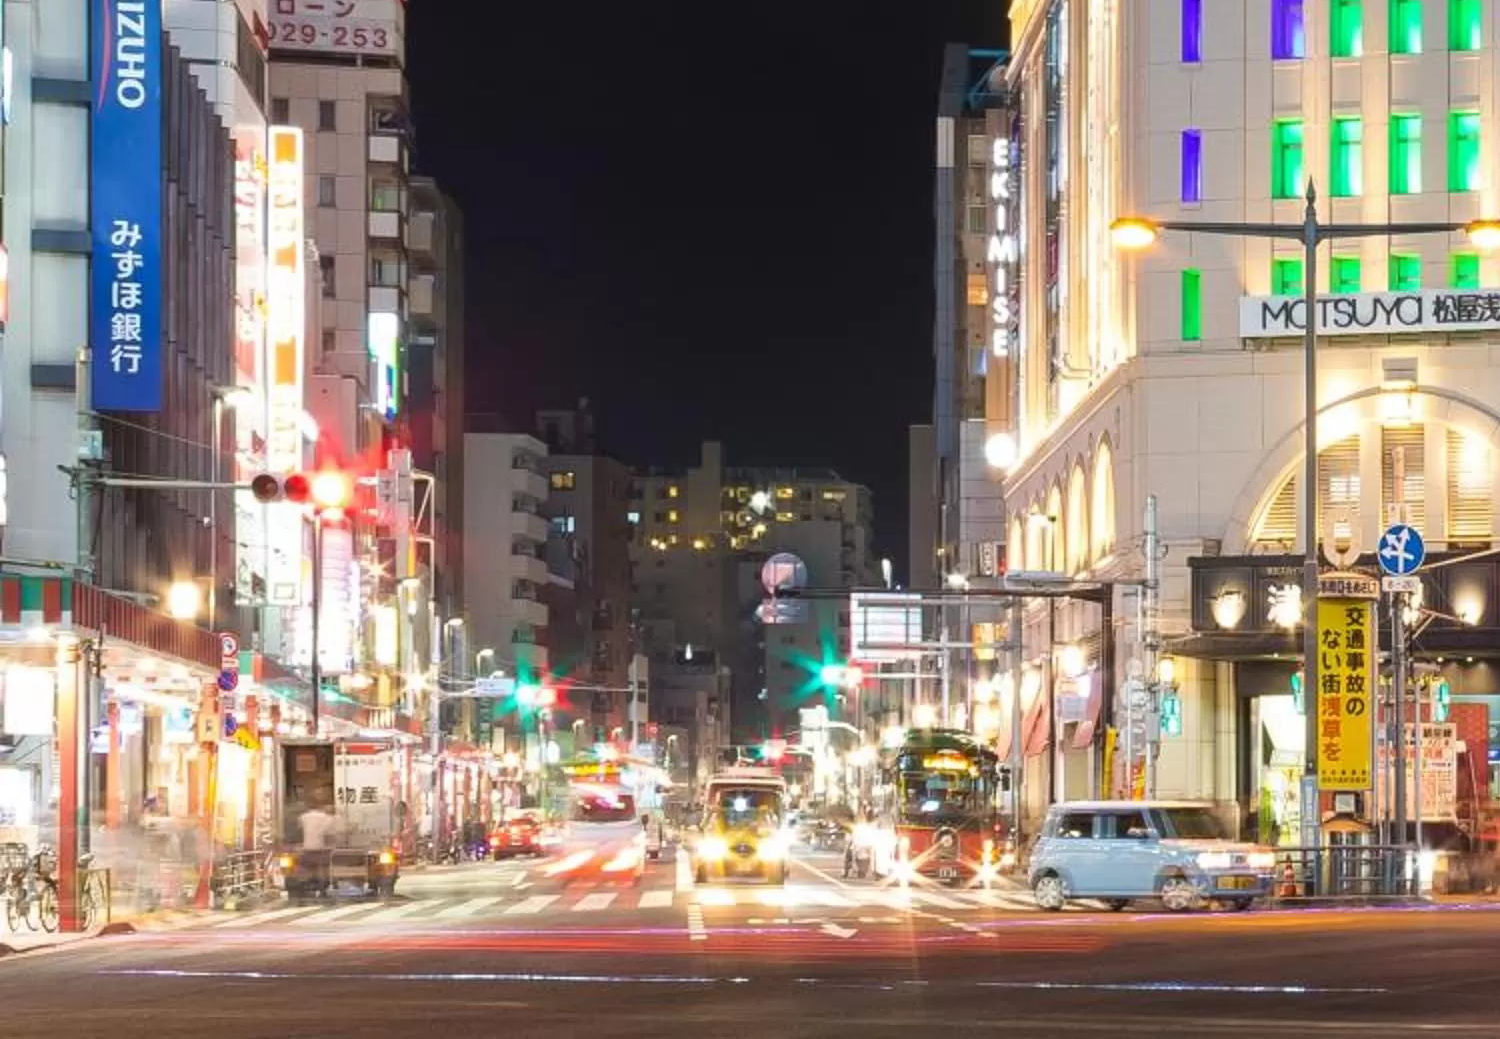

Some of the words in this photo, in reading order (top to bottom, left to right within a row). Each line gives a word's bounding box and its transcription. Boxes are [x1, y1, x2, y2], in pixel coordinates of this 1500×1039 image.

[110, 219, 144, 374] みずほ銀行
[987, 137, 1015, 357] EKIMISE
[1321, 627, 1343, 762] ない街浅草を
[1344, 606, 1366, 718] 交通事故の
